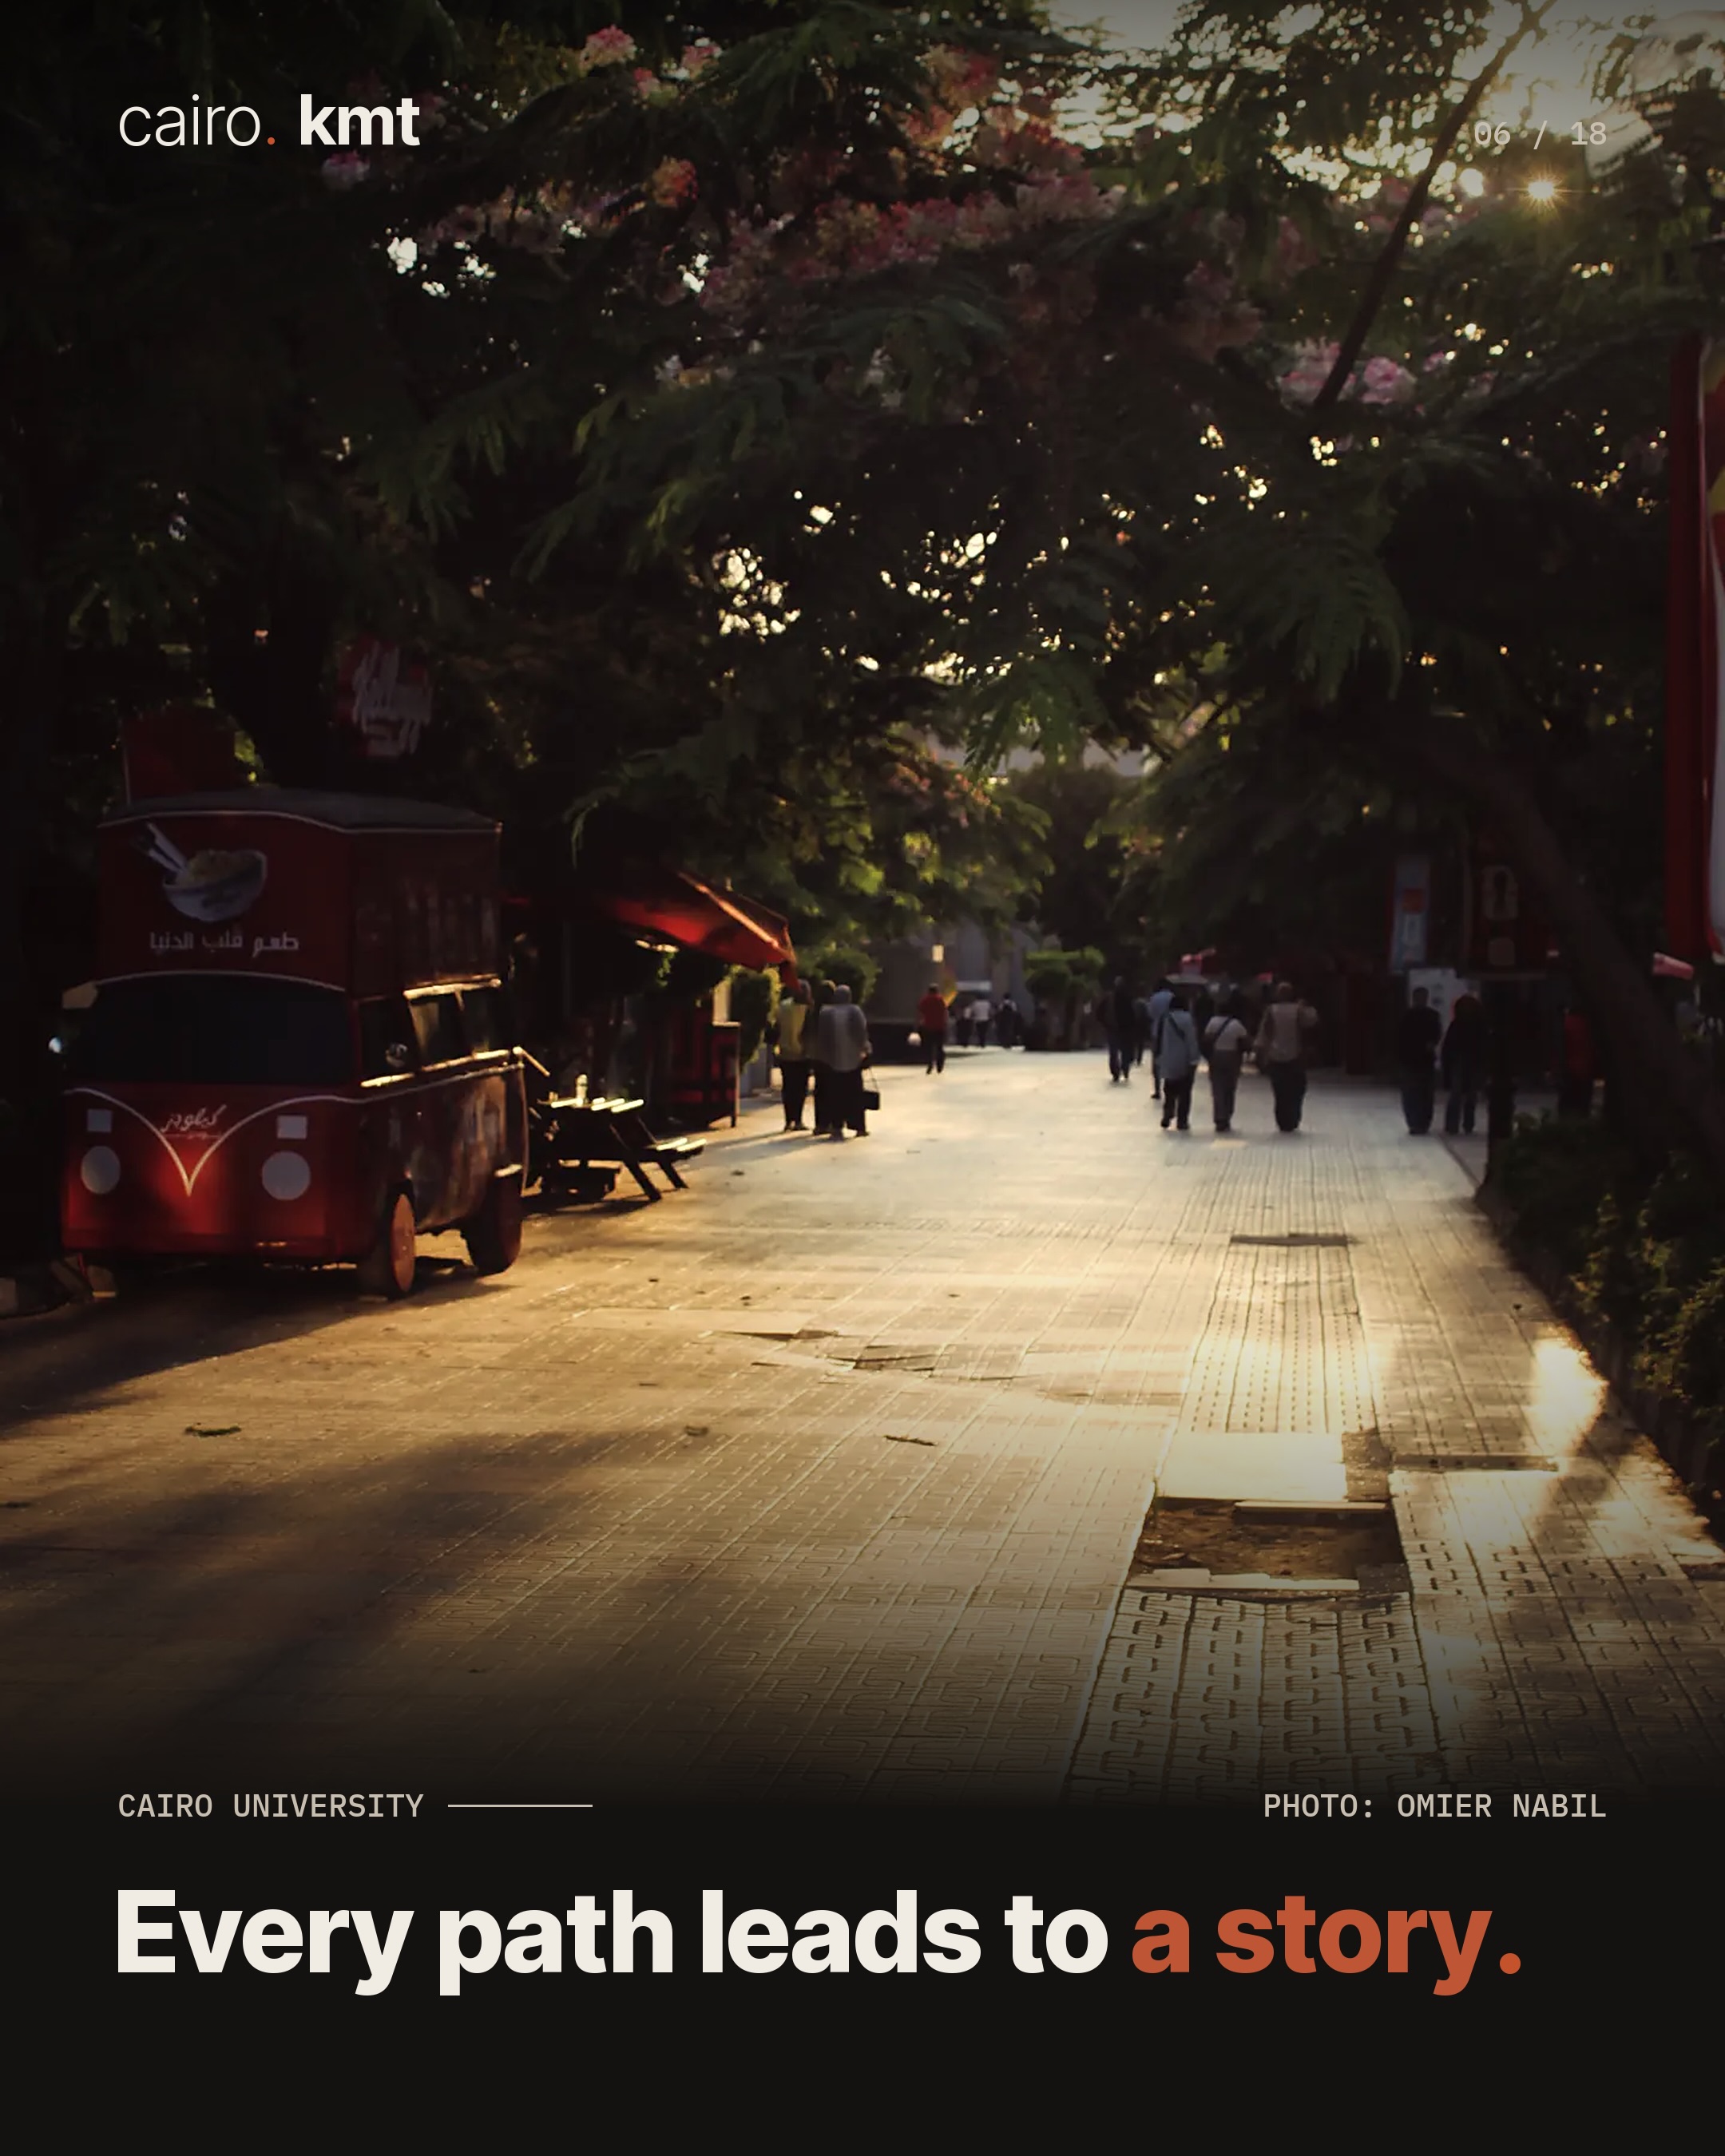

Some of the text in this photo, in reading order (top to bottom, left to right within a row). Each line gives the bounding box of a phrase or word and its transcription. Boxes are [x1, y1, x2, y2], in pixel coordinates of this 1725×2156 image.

[149, 924, 299, 958] طعم قلب الدنيا
